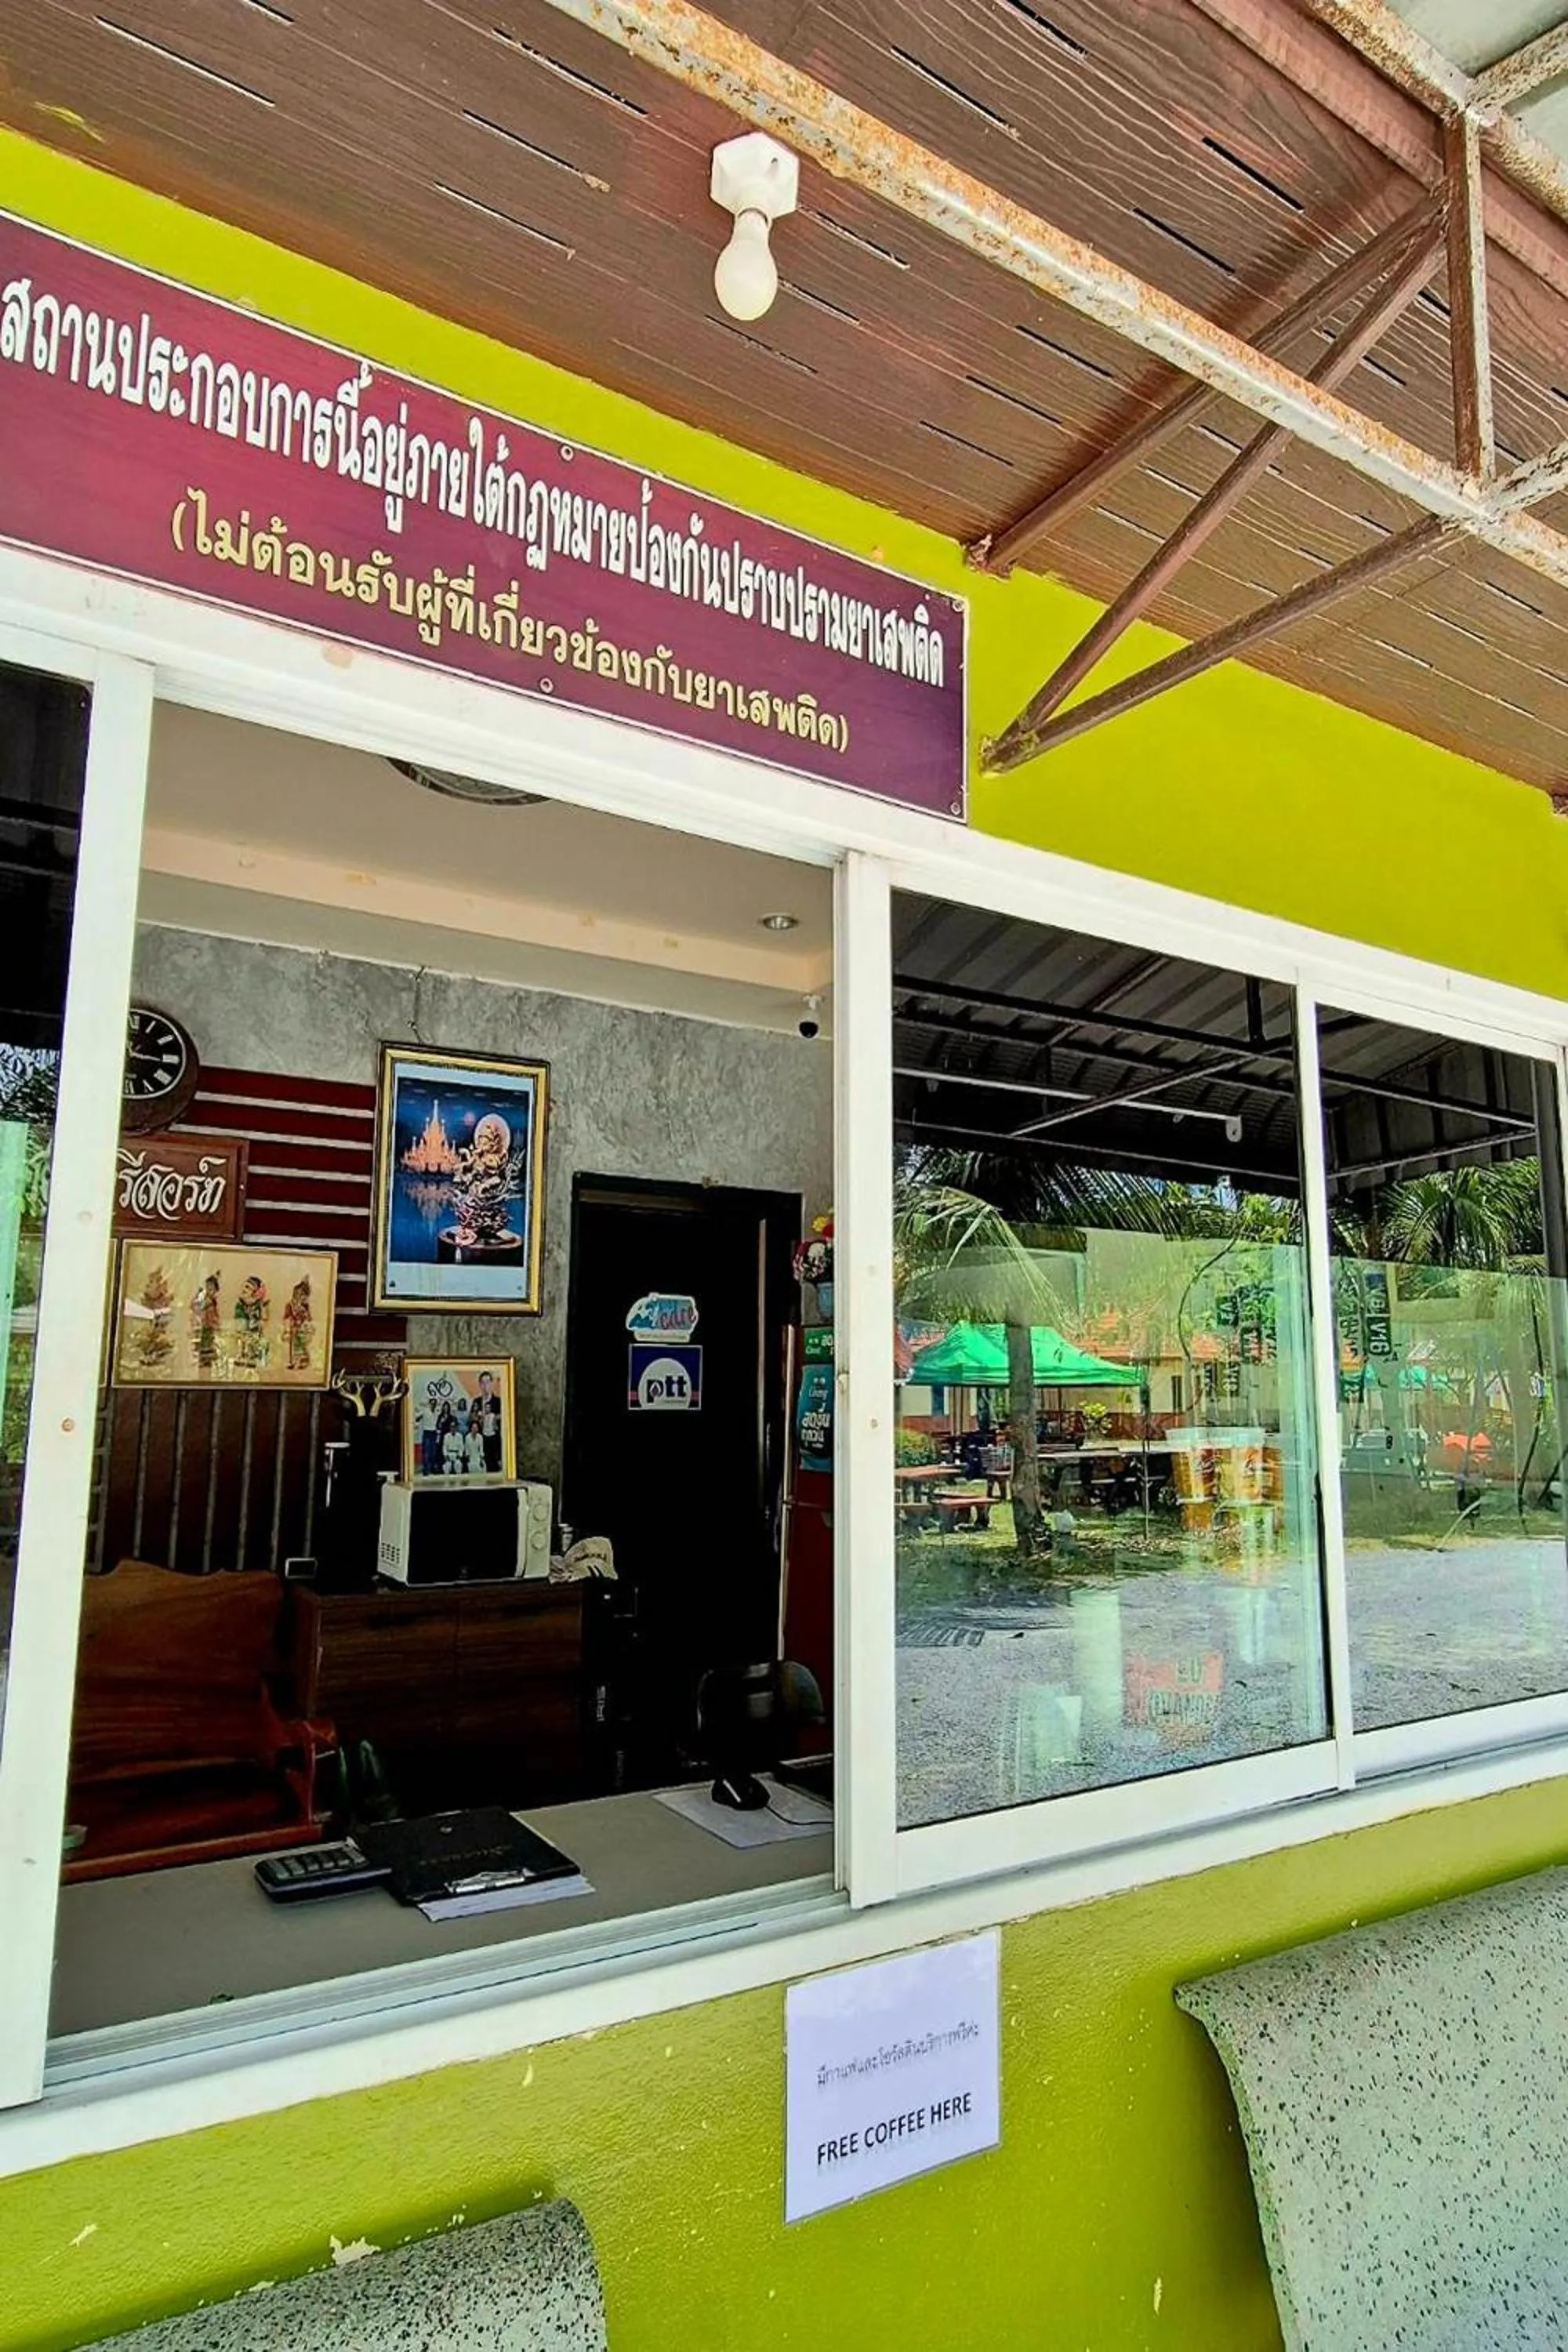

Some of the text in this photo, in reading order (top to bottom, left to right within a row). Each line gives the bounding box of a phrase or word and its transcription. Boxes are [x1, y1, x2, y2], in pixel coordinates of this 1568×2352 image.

[1369, 1322, 1390, 1352] V16
[646, 1374, 687, 1403] ptt
[817, 2092, 972, 2166] FREE COFFEE HERE
